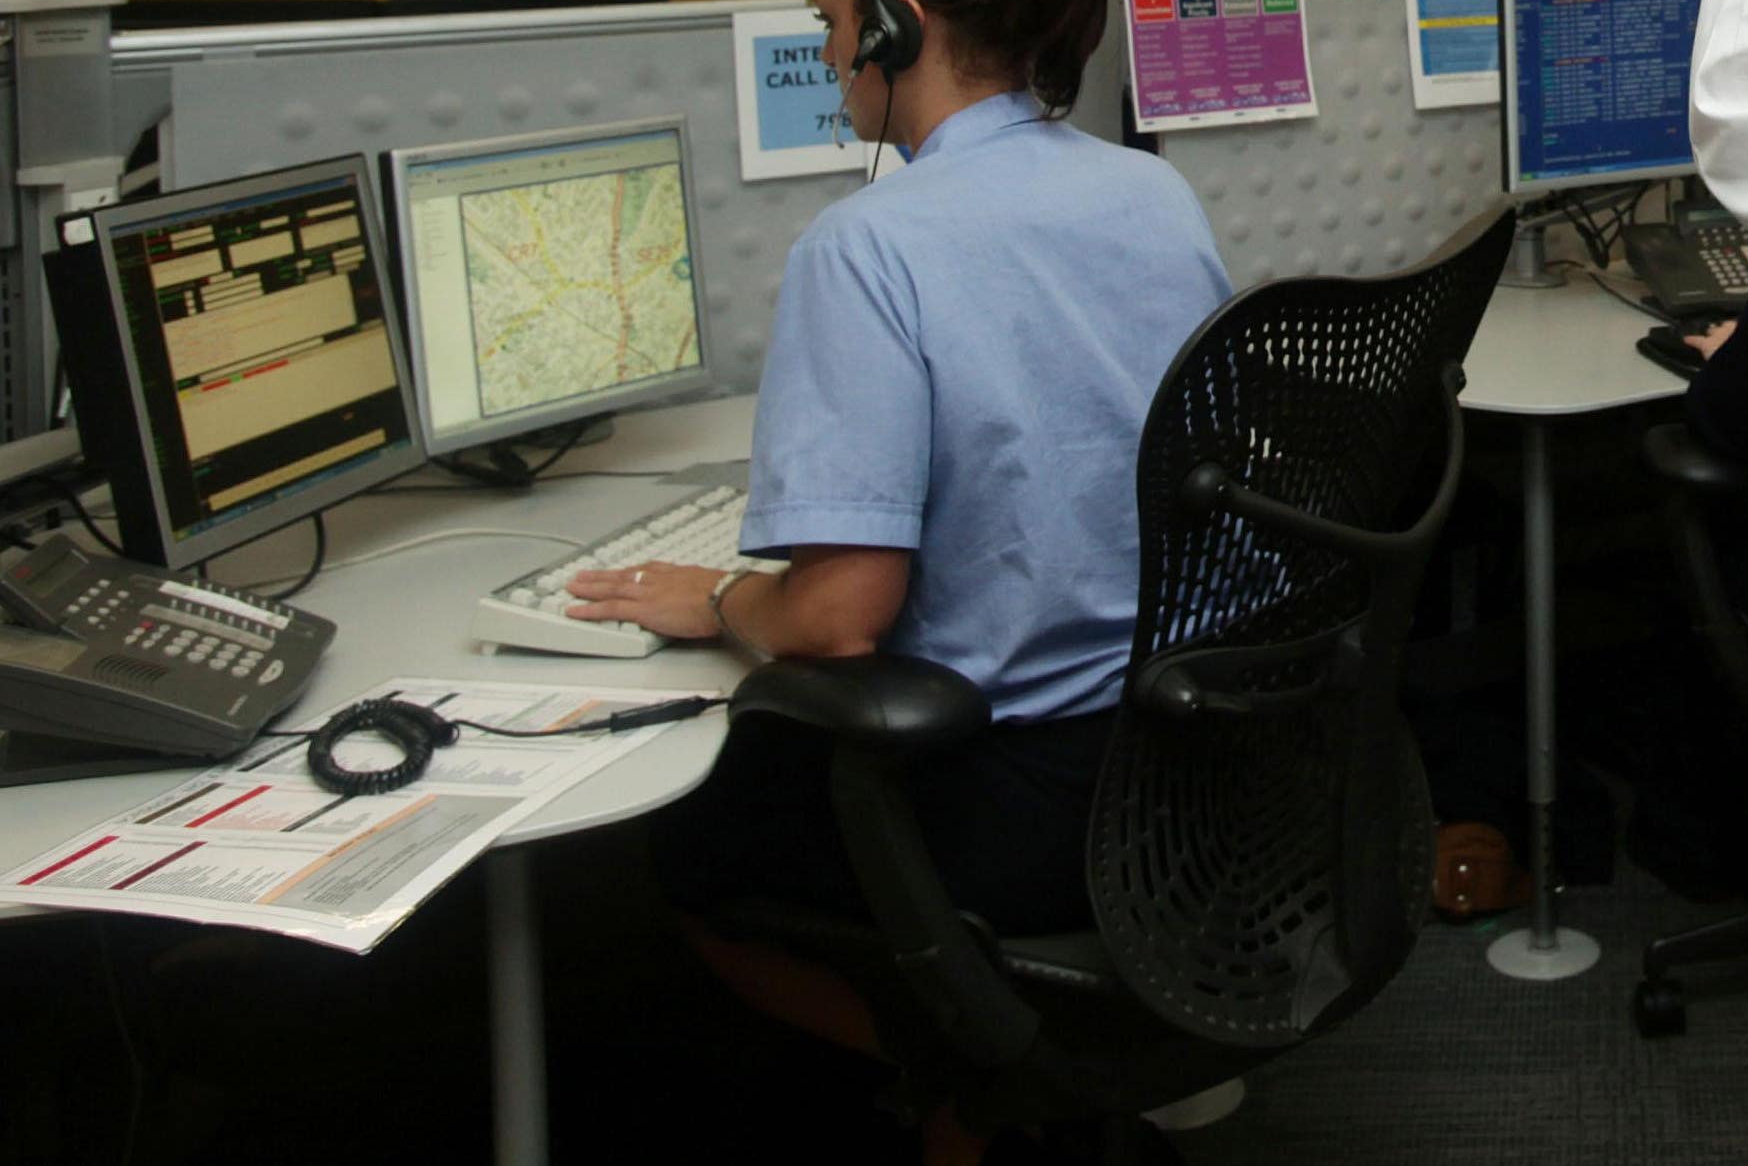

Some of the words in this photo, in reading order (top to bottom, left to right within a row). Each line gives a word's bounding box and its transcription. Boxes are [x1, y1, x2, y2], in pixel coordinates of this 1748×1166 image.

[772, 45, 822, 65] INTE
[766, 71, 819, 89] CALL
[825, 68, 839, 84] D
